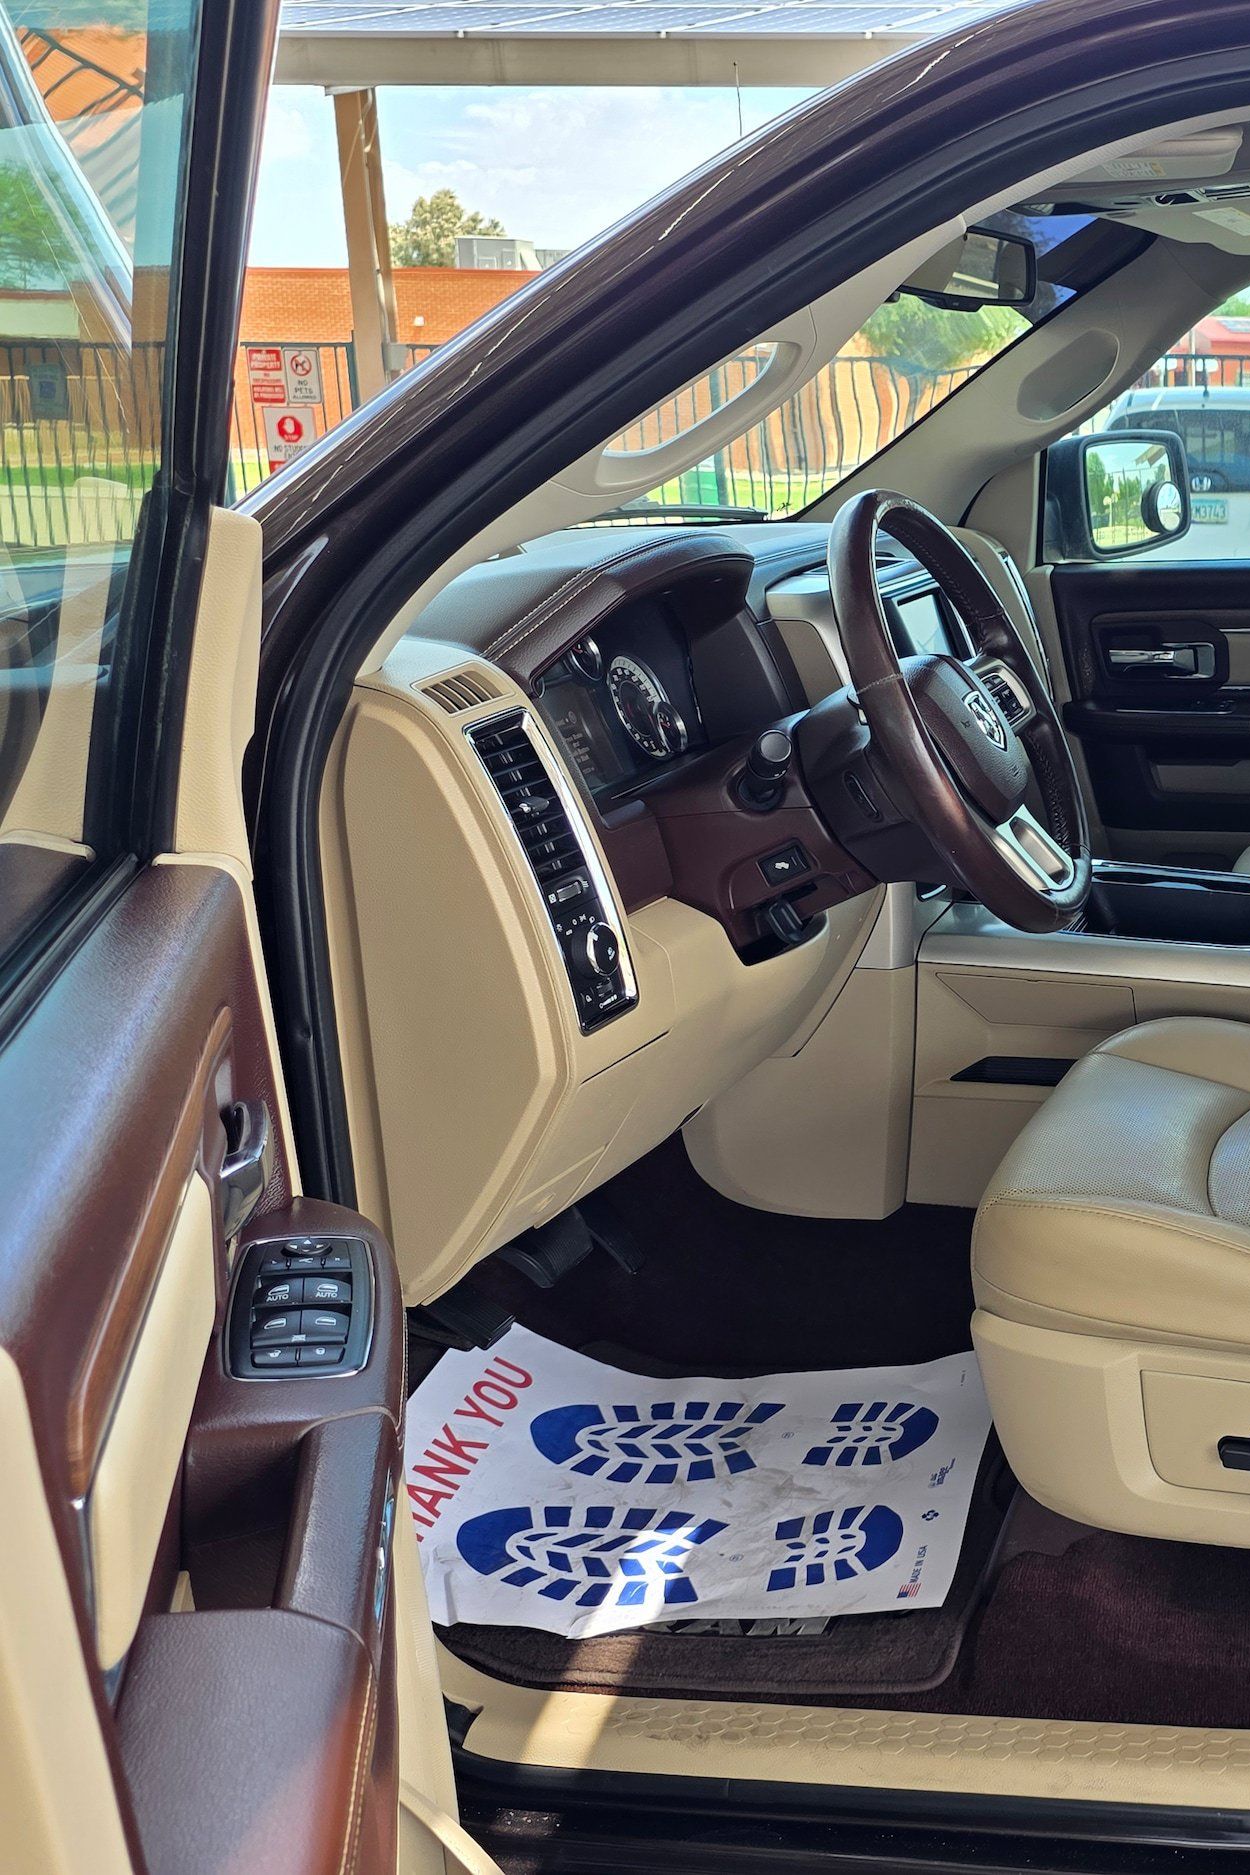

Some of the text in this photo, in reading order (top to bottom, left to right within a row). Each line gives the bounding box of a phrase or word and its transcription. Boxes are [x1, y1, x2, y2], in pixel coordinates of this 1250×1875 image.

[266, 1294, 289, 1302] AUTO
[406, 1356, 533, 1542] ANK YOU
[909, 1568, 922, 1583] MADE
[917, 1545, 928, 1558] USA
